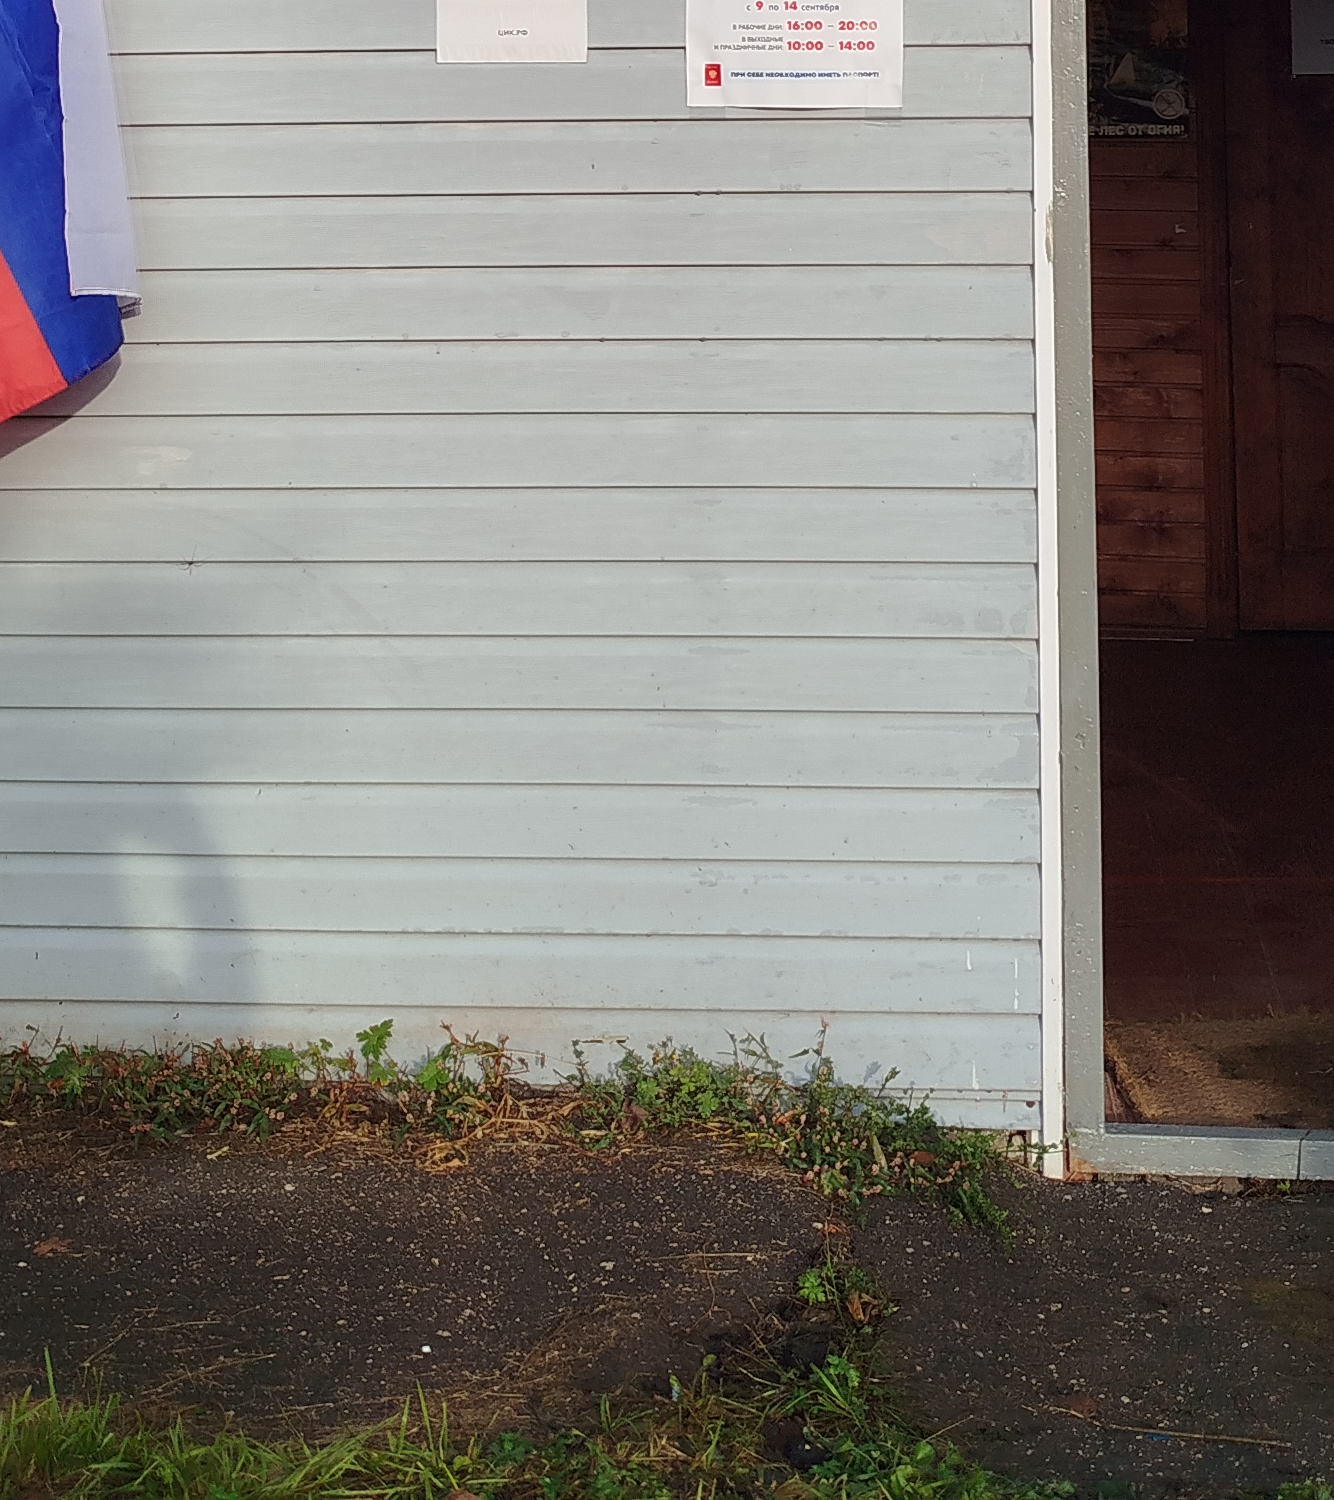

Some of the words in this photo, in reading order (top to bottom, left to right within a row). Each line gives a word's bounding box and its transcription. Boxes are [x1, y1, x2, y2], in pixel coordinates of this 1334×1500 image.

[755, 0, 764, 11] 9
[783, 0, 798, 11] 14
[801, 2, 840, 13] сентября
[787, 20, 823, 31] 16:00
[838, 20, 878, 31] 20:00
[787, 41, 824, 51] 10:00
[838, 41, 875, 51] 14:00
[1098, 125, 1124, 136] ЛЕС
[1128, 124, 1144, 136] ОТ
